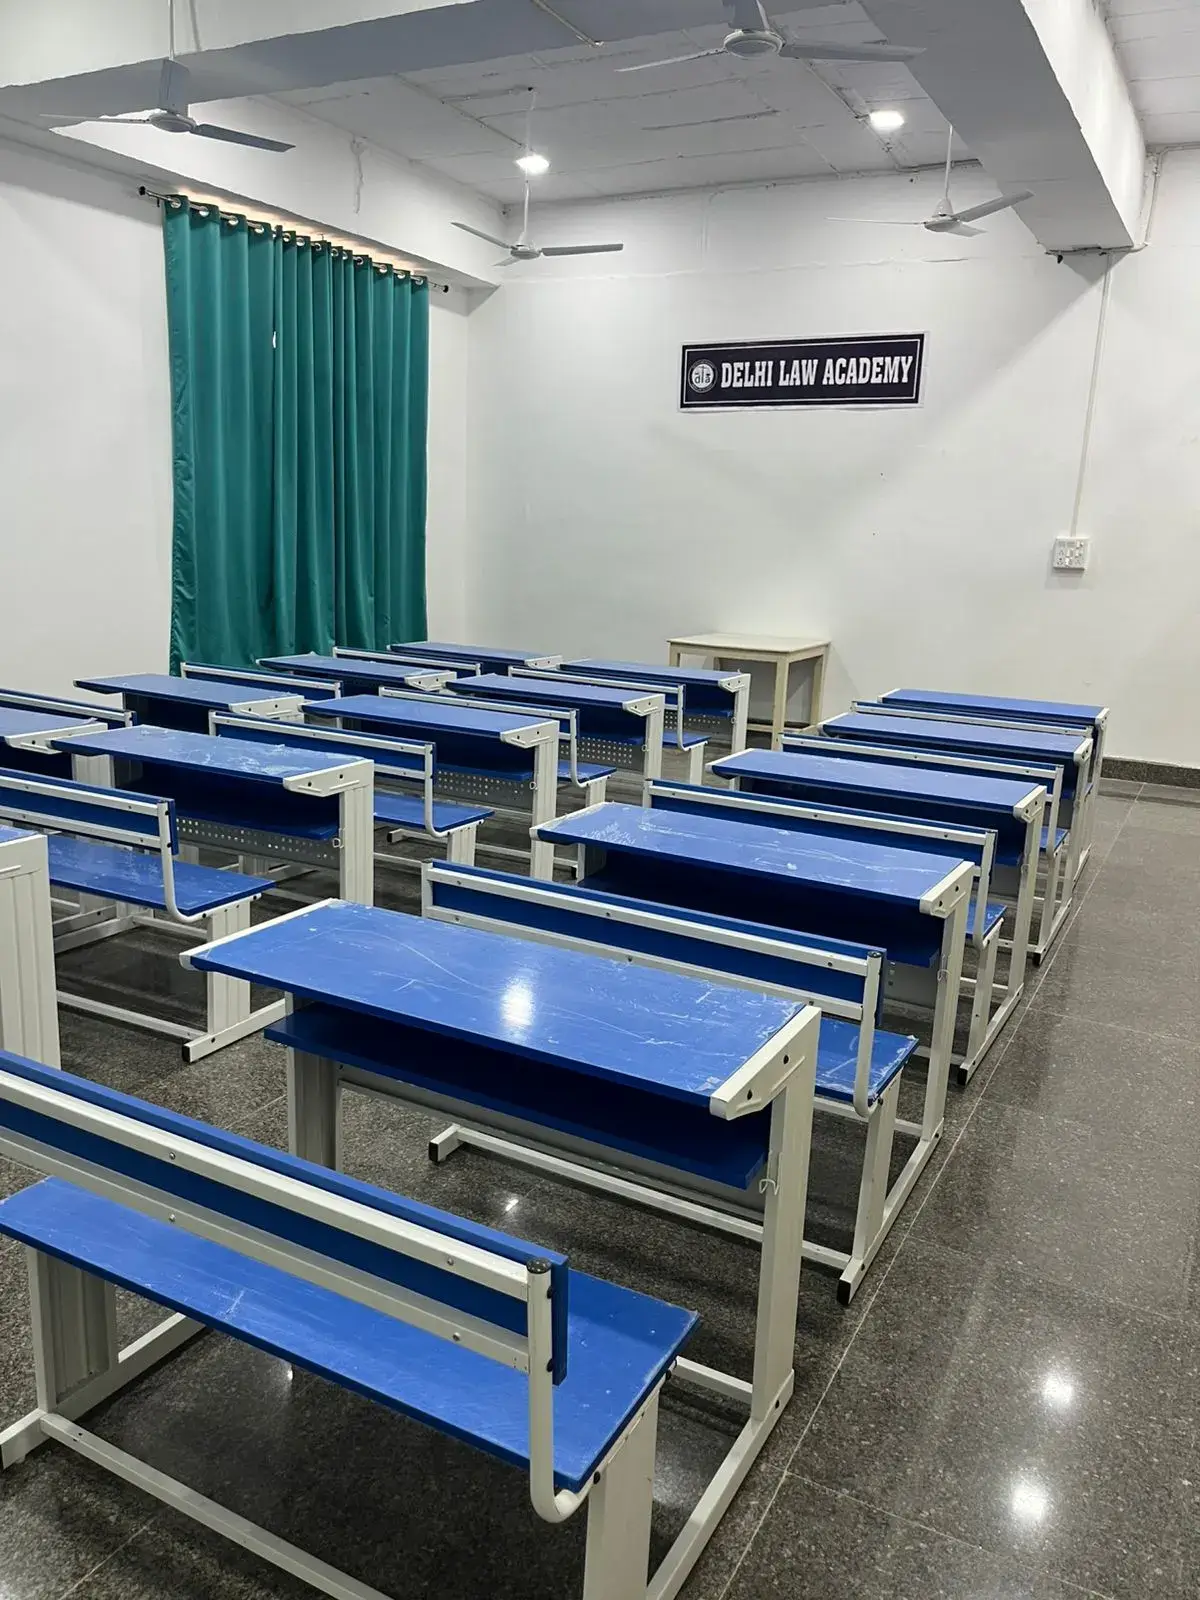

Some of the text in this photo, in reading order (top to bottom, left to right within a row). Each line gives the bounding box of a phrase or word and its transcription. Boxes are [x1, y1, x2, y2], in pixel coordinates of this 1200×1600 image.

[720, 360, 774, 388] DELHI
[778, 358, 819, 387] LAW
[822, 355, 914, 386] ACADEMY
